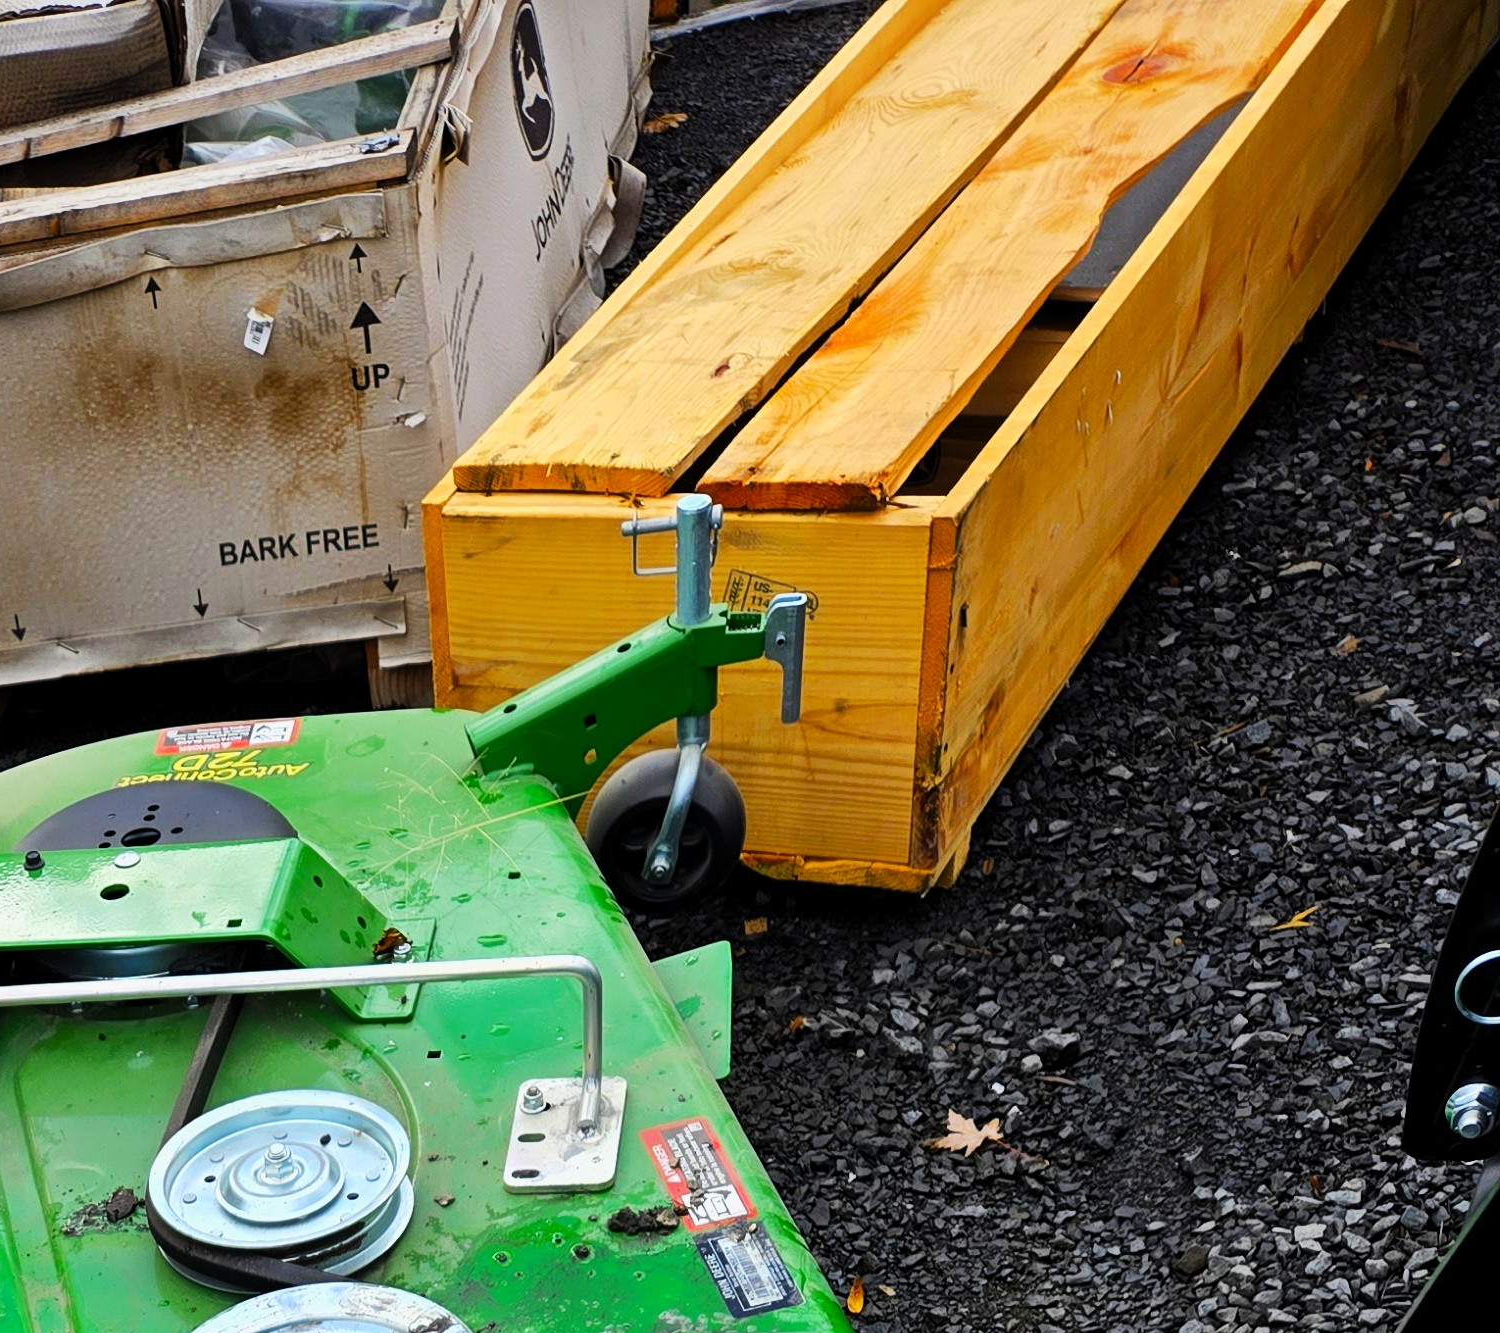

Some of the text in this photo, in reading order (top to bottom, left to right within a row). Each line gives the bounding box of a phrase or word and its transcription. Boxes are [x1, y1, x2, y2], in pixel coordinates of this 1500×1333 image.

[351, 363, 390, 391] UP
[219, 523, 380, 566] BARK FREE
[172, 749, 263, 773] 72D
[651, 1144, 676, 1176] DANGER
[703, 1253, 736, 1300] JOHN DEERE
